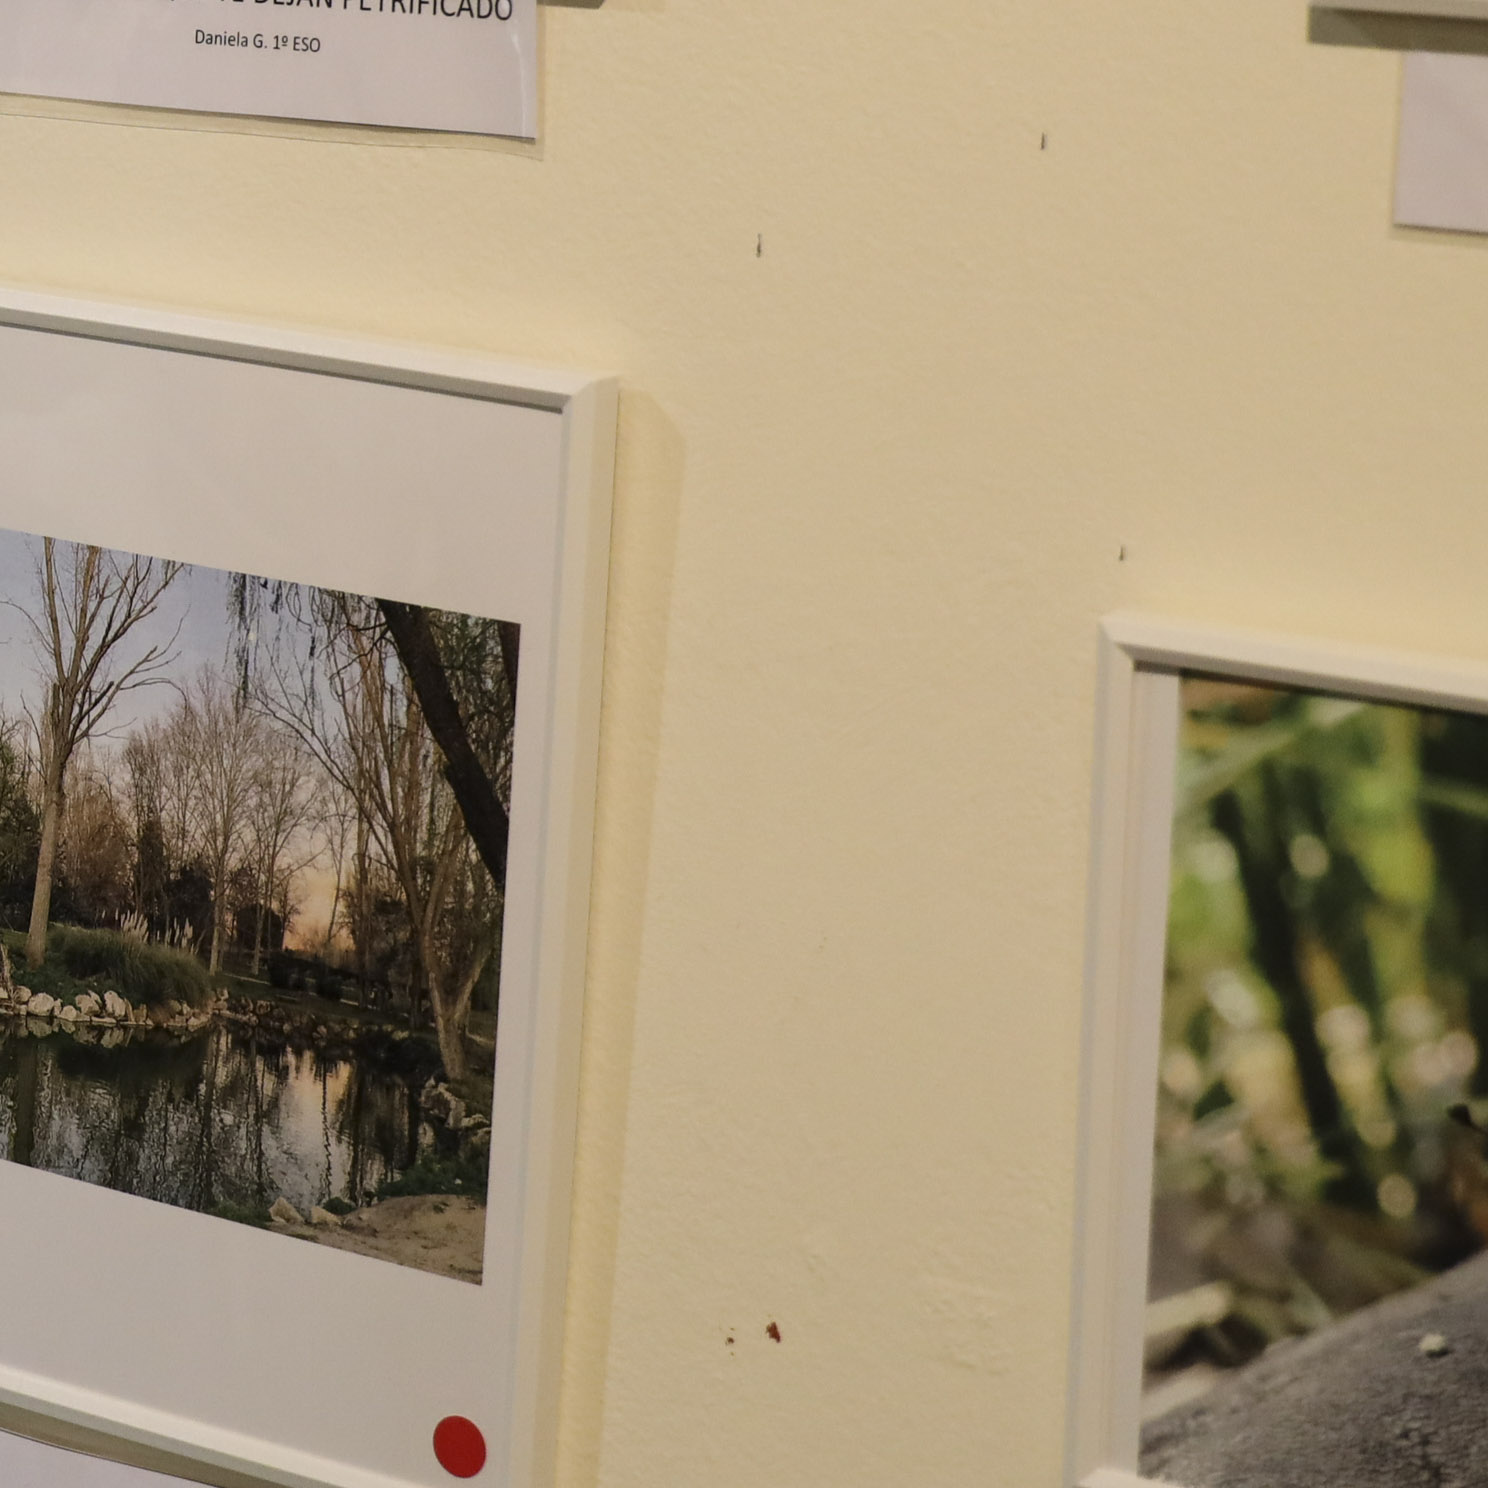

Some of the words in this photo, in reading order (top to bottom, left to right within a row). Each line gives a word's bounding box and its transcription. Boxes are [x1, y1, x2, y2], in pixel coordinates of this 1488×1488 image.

[194, 28, 249, 49] Daniela
[253, 33, 269, 50] G.
[273, 35, 289, 50] 1º
[293, 36, 321, 53] ESO
